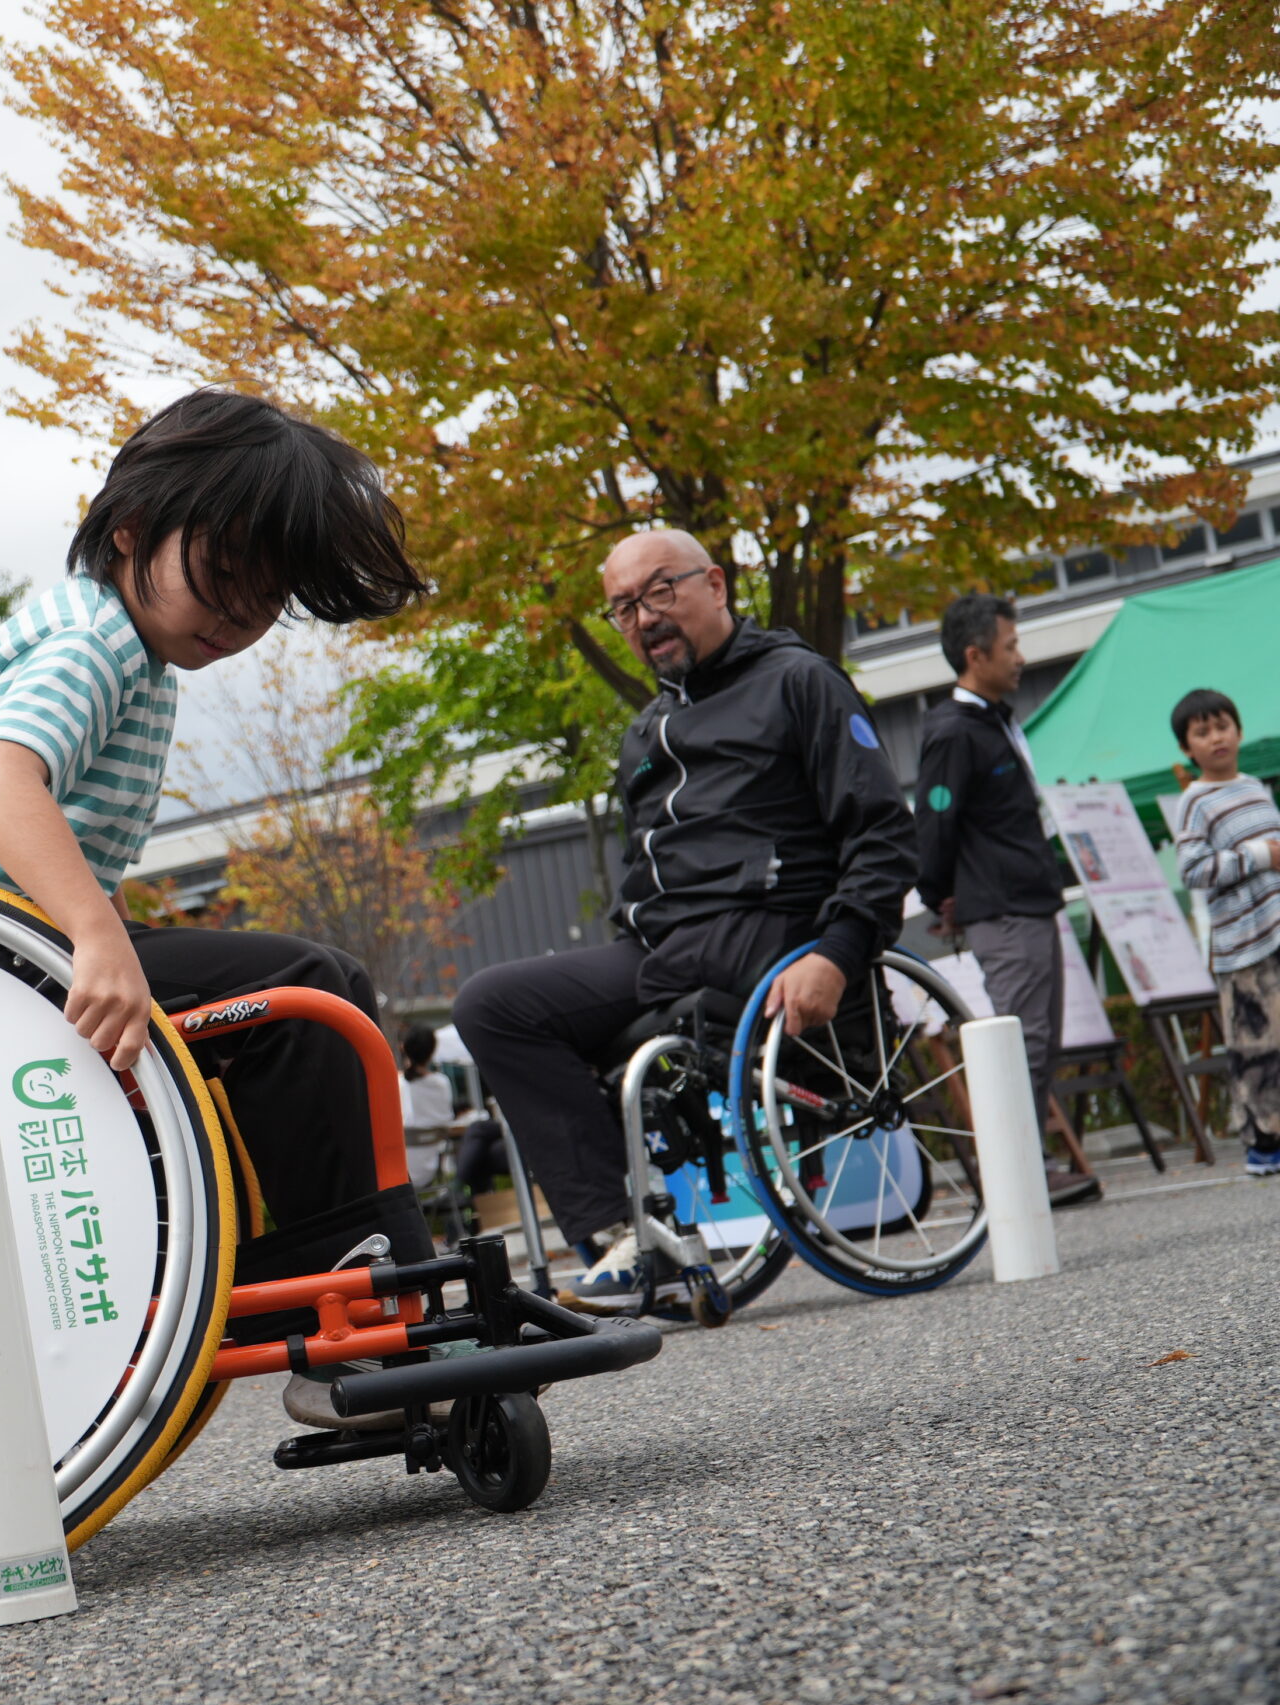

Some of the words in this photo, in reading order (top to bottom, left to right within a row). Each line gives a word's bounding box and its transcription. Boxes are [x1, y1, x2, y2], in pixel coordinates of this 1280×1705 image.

[30, 1193, 48, 1251] PARASPORTS
[45, 1191, 57, 1211] THE
[48, 1213, 64, 1255] NIPPON
[41, 1253, 56, 1294] SUPPORT
[61, 1189, 119, 1325] パラサポ
[48, 1296, 62, 1331] CENTER
[57, 1257, 77, 1329] FOUNDATION
